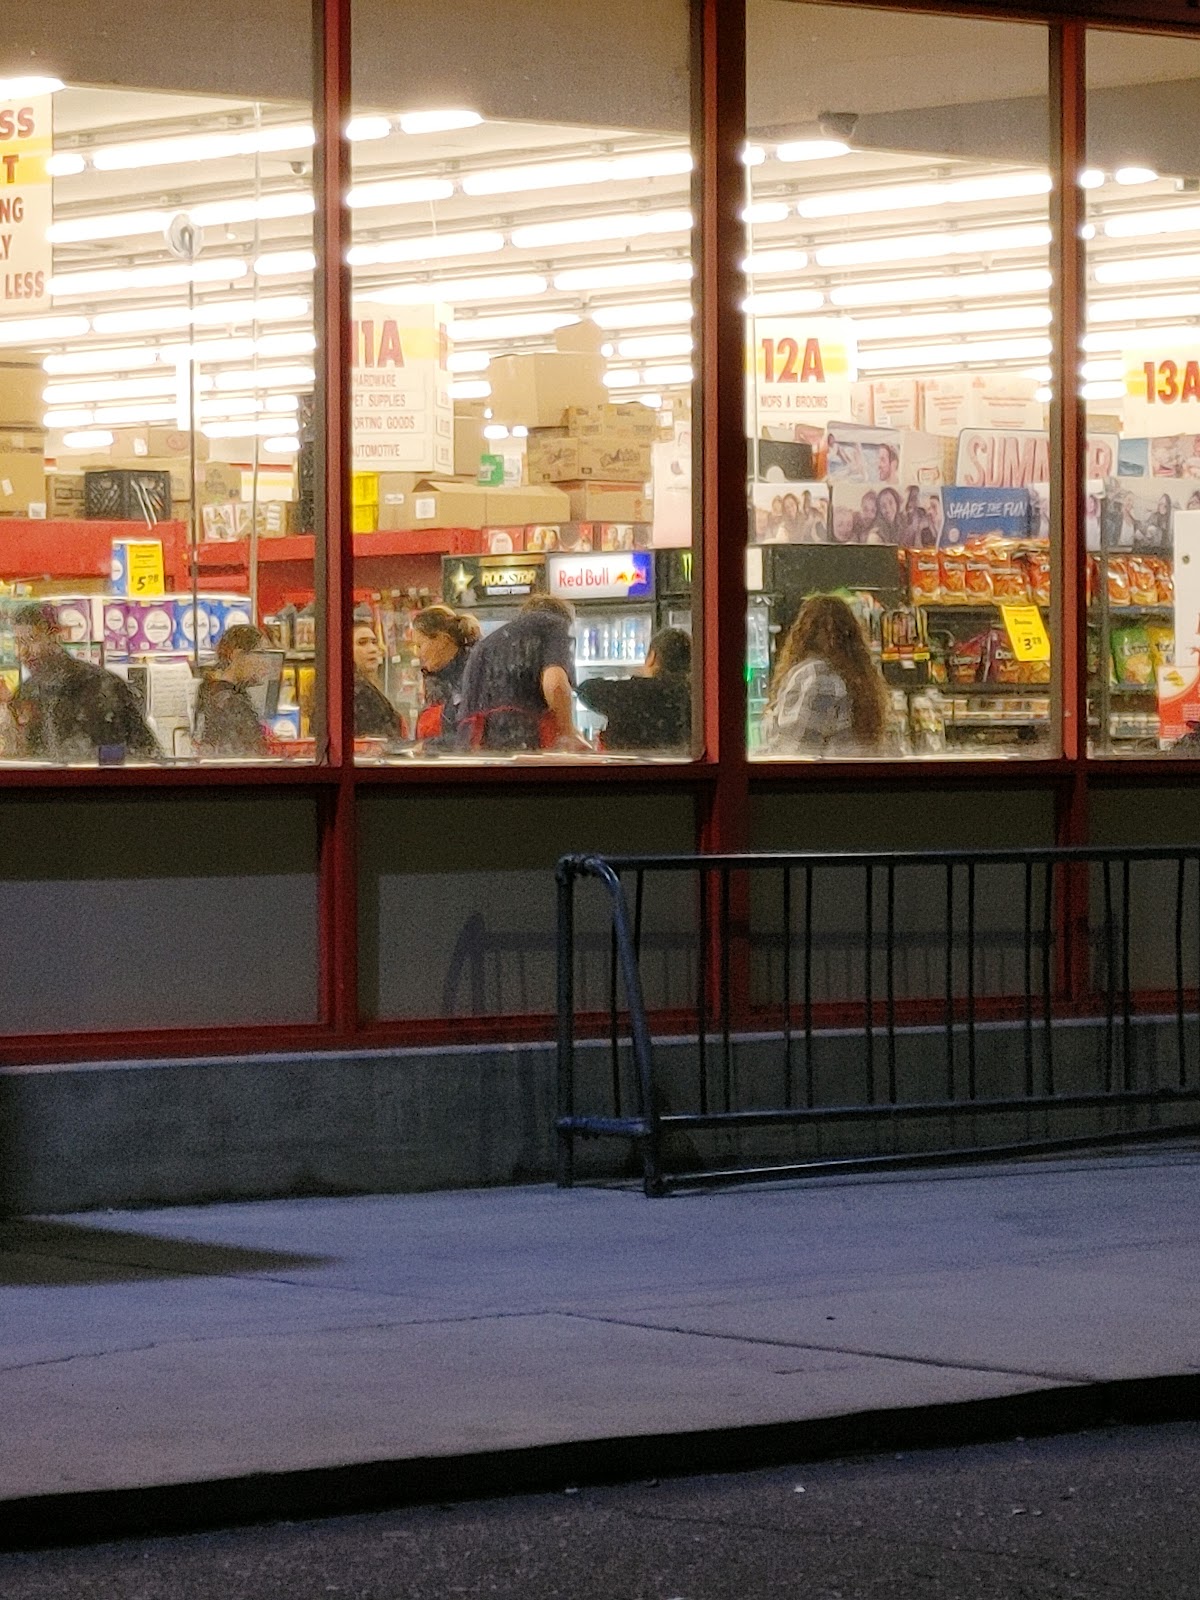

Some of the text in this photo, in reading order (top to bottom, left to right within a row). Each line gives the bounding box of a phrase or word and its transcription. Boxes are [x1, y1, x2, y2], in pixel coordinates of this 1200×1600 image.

[5, 270, 45, 300] LESS
[761, 337, 826, 383] 12A
[1143, 360, 1200, 404] 13A
[369, 394, 406, 407] SUPPLIES
[353, 416, 415, 430] ORTING GOODS
[352, 443, 400, 458] UTOMOTIVE
[965, 434, 1113, 487] SUMR
[947, 501, 987, 519] SHARE
[1003, 501, 1028, 518] FUN
[559, 567, 609, 588] Red Bull
